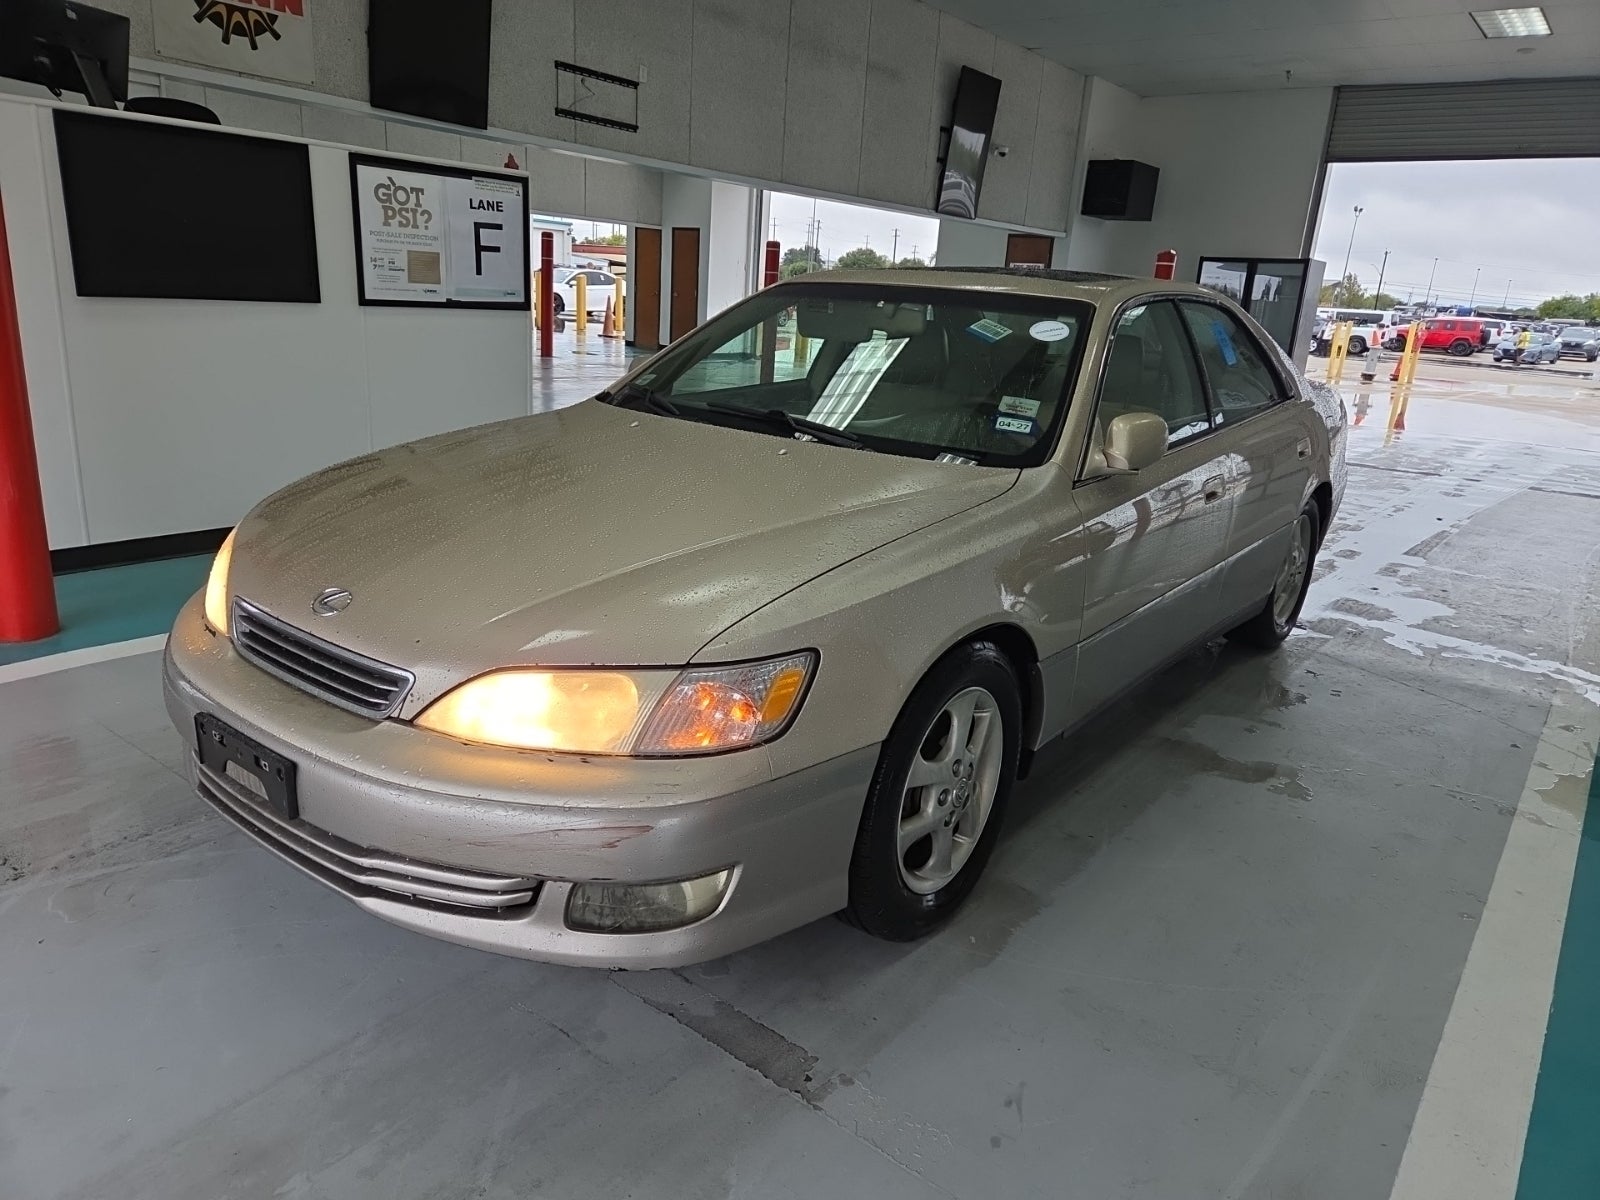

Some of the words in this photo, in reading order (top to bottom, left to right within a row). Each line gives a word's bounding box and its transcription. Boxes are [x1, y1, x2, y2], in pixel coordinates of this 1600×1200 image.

[382, 205, 432, 230] PSI?
[469, 198, 504, 212] LANE
[473, 221, 503, 276] F
